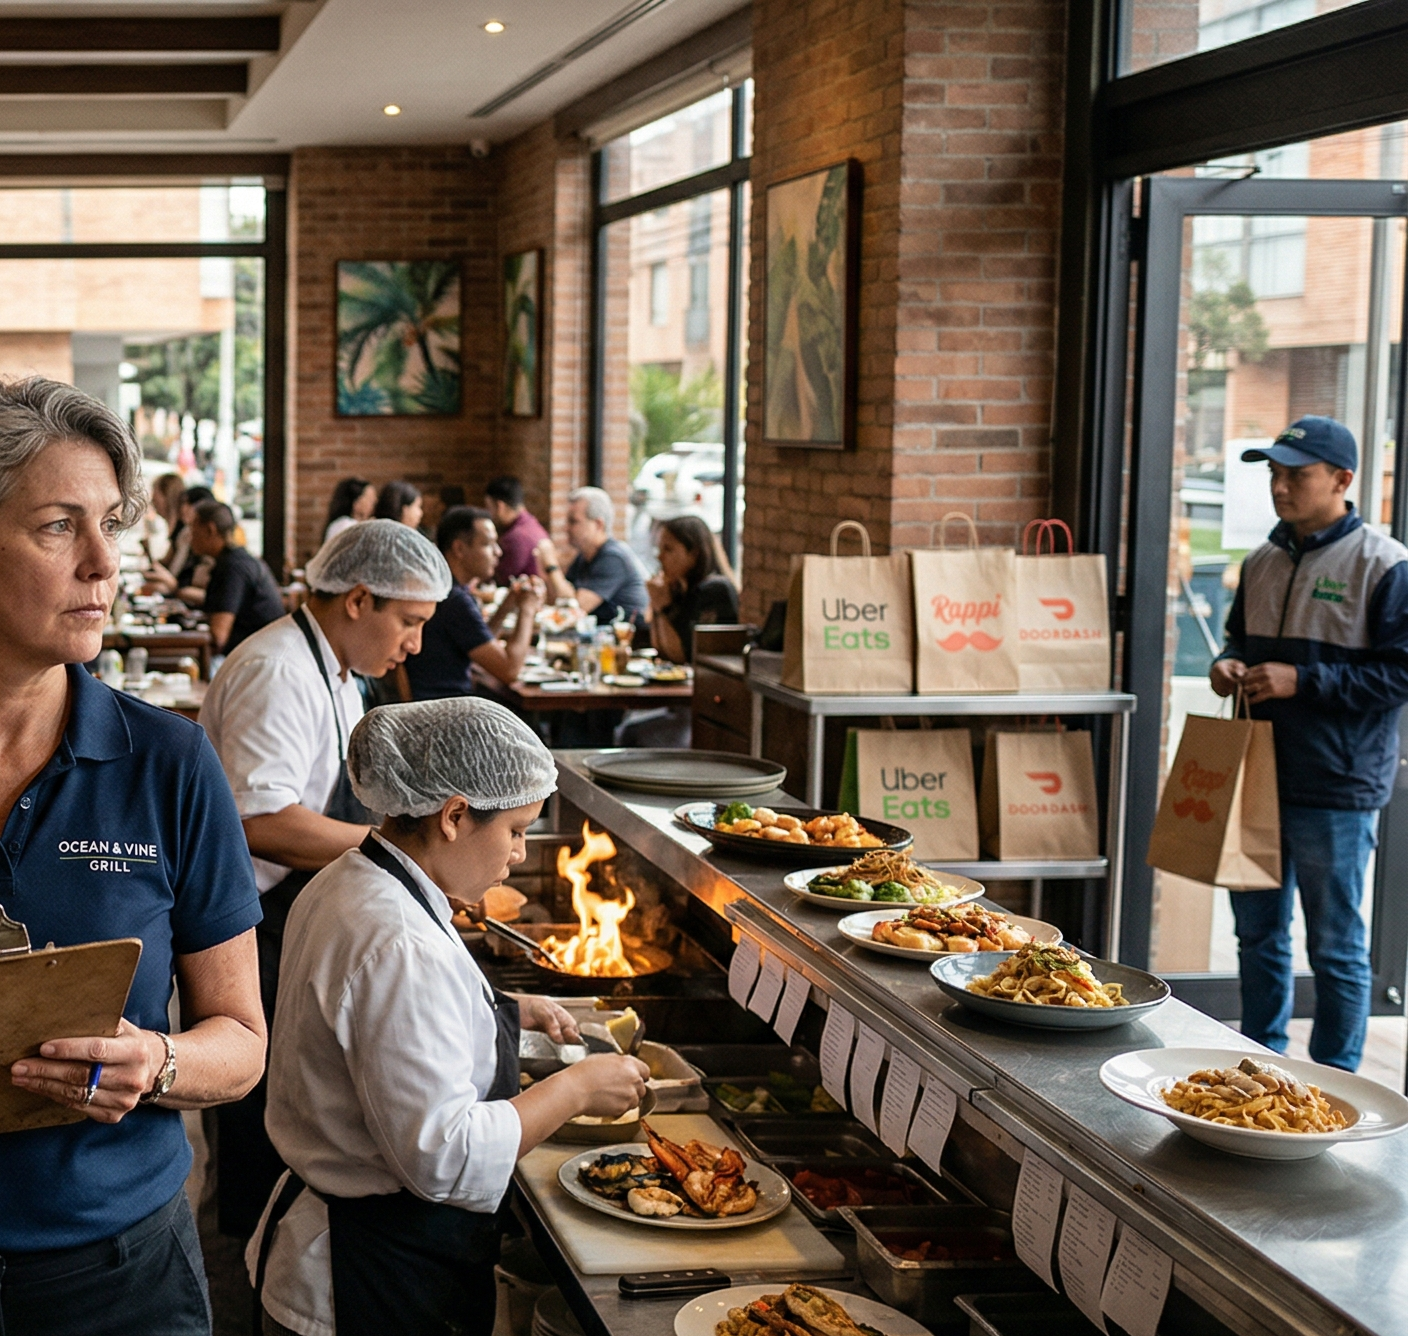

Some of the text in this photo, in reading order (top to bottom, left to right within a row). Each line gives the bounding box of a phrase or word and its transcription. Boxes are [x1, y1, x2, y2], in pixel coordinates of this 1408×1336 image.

[822, 598, 888, 622] Uber
[930, 593, 1002, 626] Rappi
[823, 625, 890, 650] Eats
[1019, 629, 1102, 640] DOORDASH
[881, 767, 947, 791] Uber
[882, 795, 951, 819] Eats
[58, 840, 157, 857] OCEAN & VINE
[89, 860, 131, 872] GRILL
